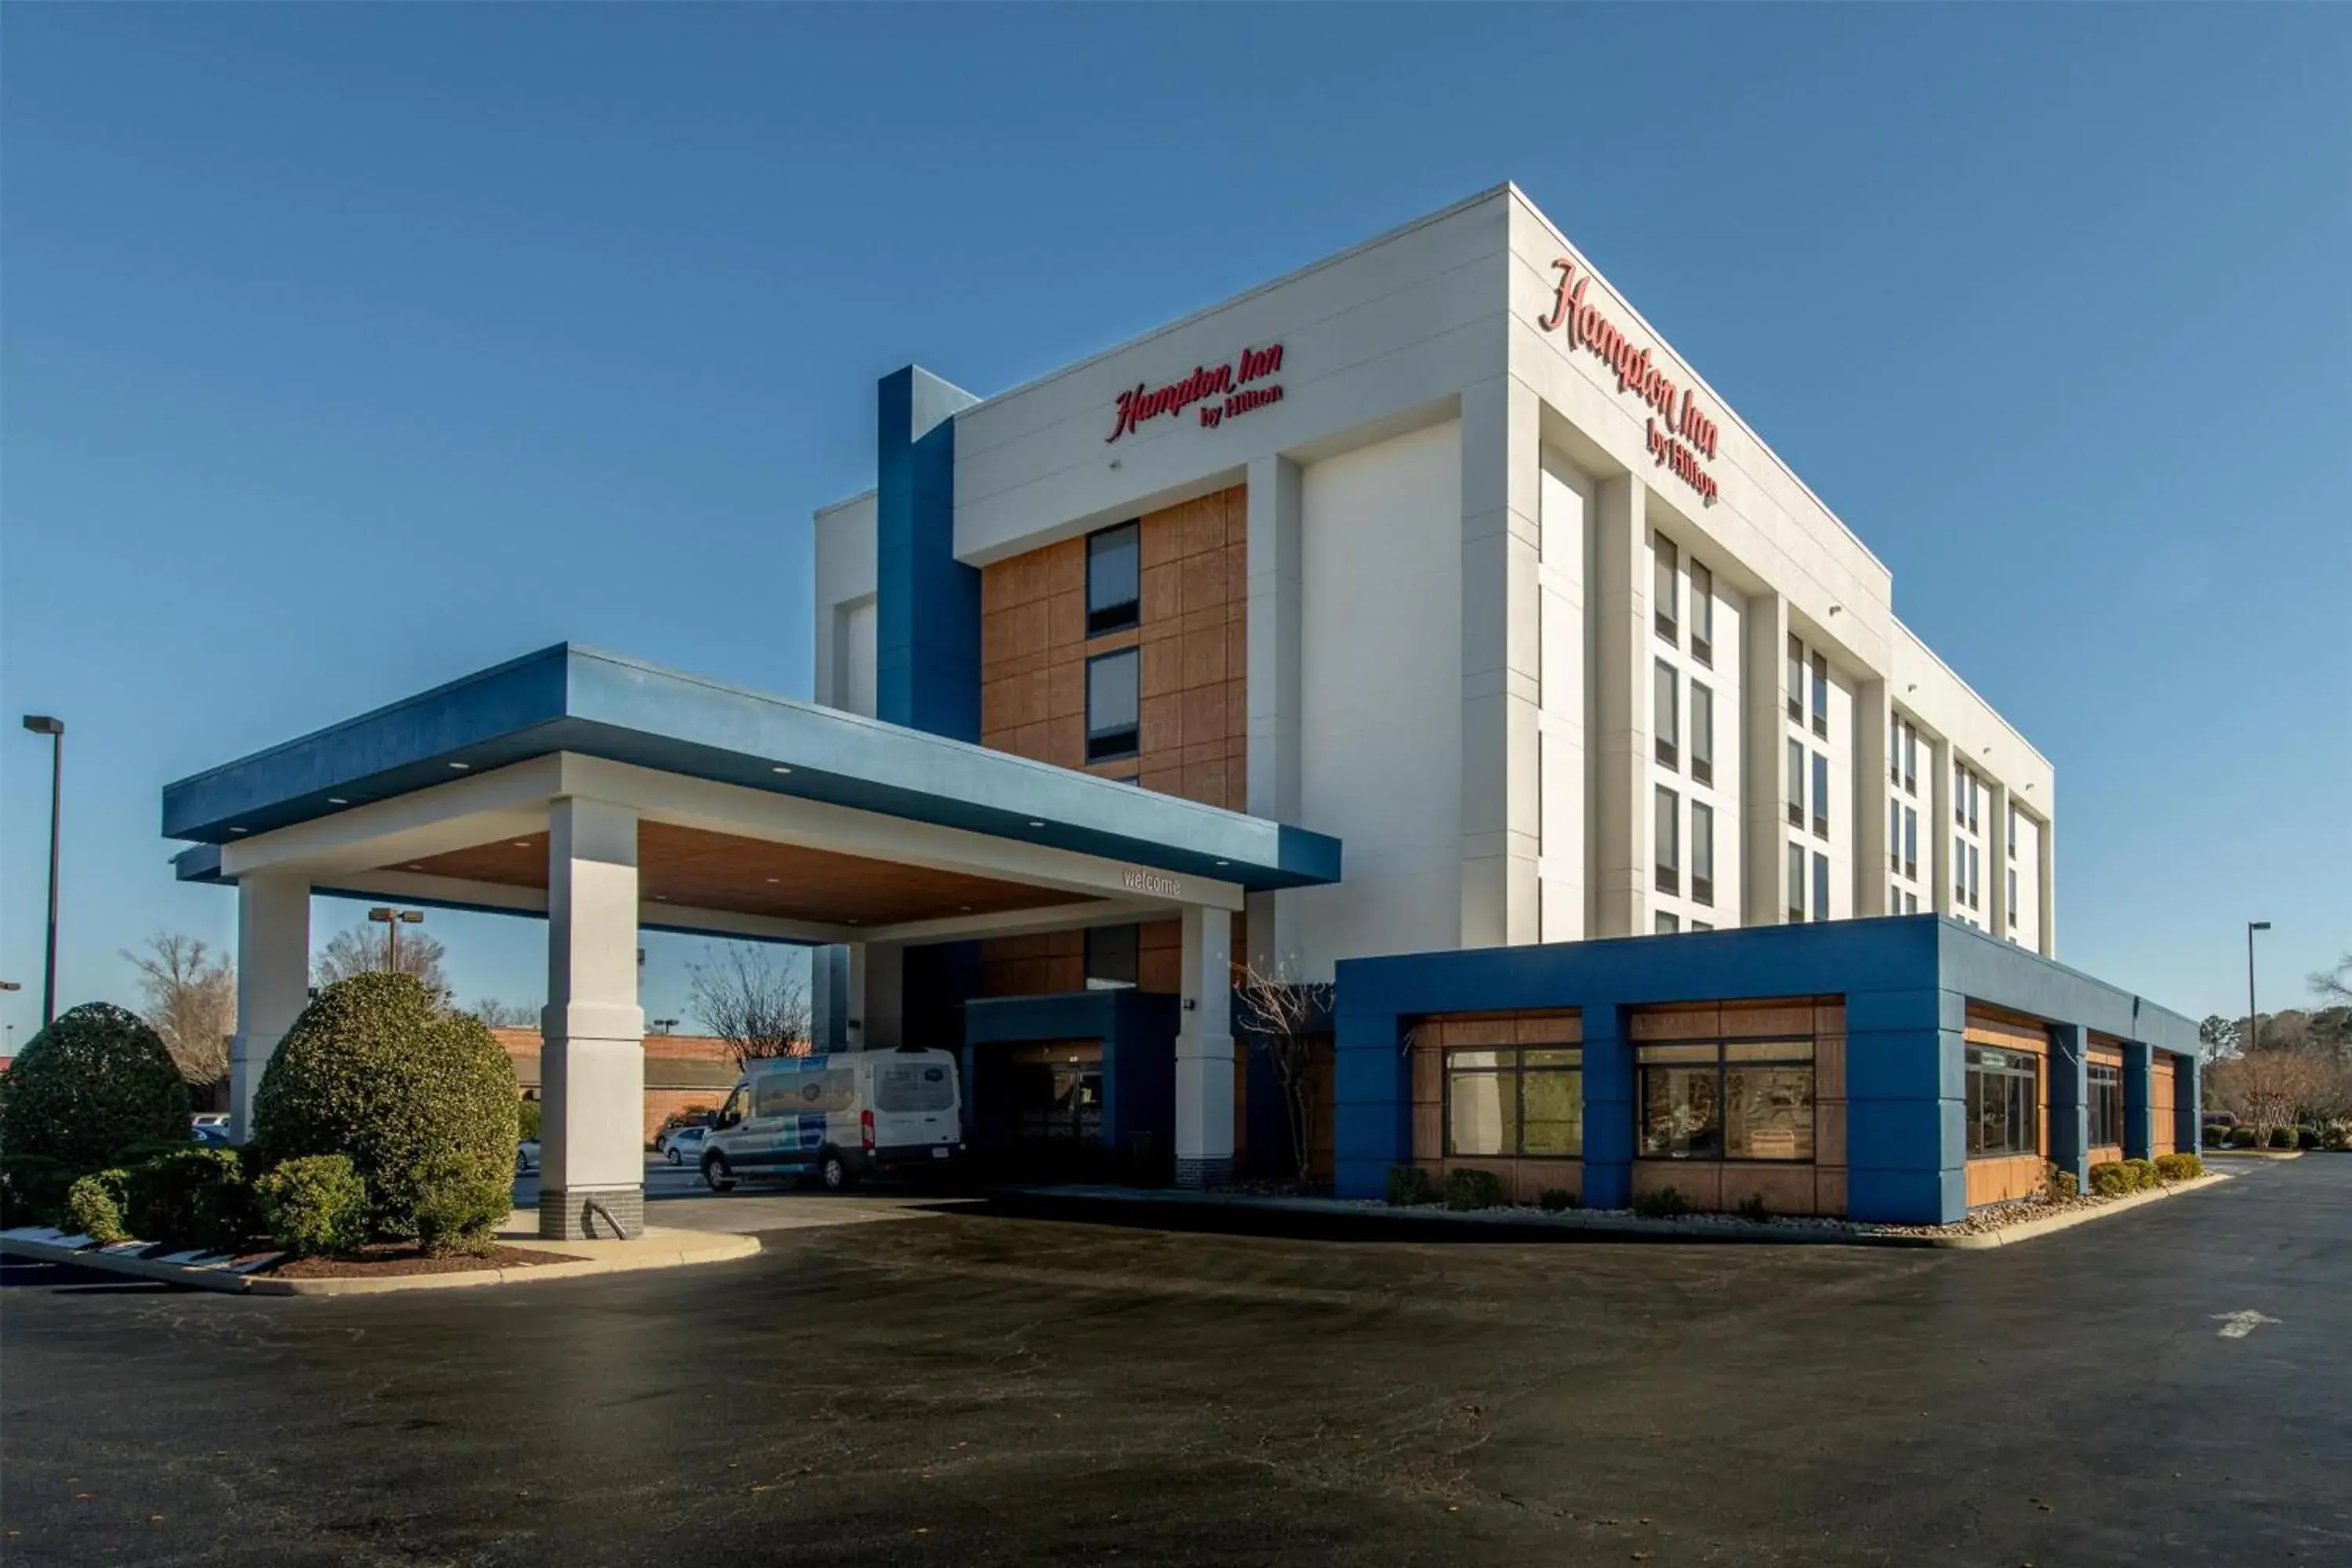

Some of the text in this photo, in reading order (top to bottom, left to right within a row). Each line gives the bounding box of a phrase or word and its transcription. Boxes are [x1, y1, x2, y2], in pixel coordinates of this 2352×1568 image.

[1105, 344, 1283, 444] Hampton Inn
[1537, 257, 1717, 461] Hampton Inn
[1200, 385, 1283, 428] by Hilton
[1646, 418, 1717, 504] by Hilton
[1123, 868, 1181, 895] welcome
